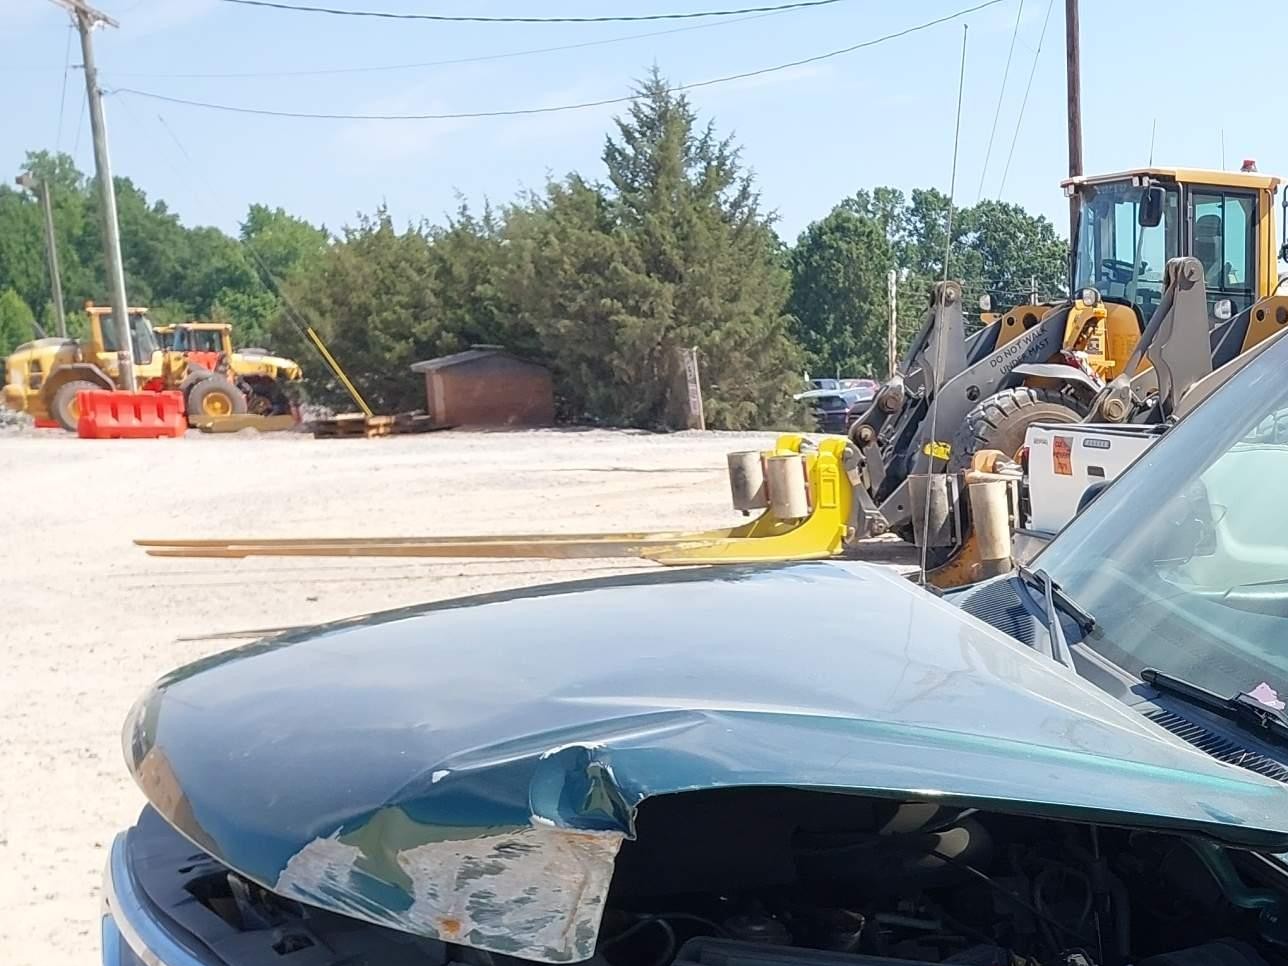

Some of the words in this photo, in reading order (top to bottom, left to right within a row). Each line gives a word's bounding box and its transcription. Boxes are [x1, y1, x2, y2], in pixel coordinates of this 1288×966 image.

[989, 356, 1003, 367] DO
[1003, 342, 1022, 359] NOT
[1022, 327, 1048, 345] WALK
[1028, 338, 1049, 356] MAST
